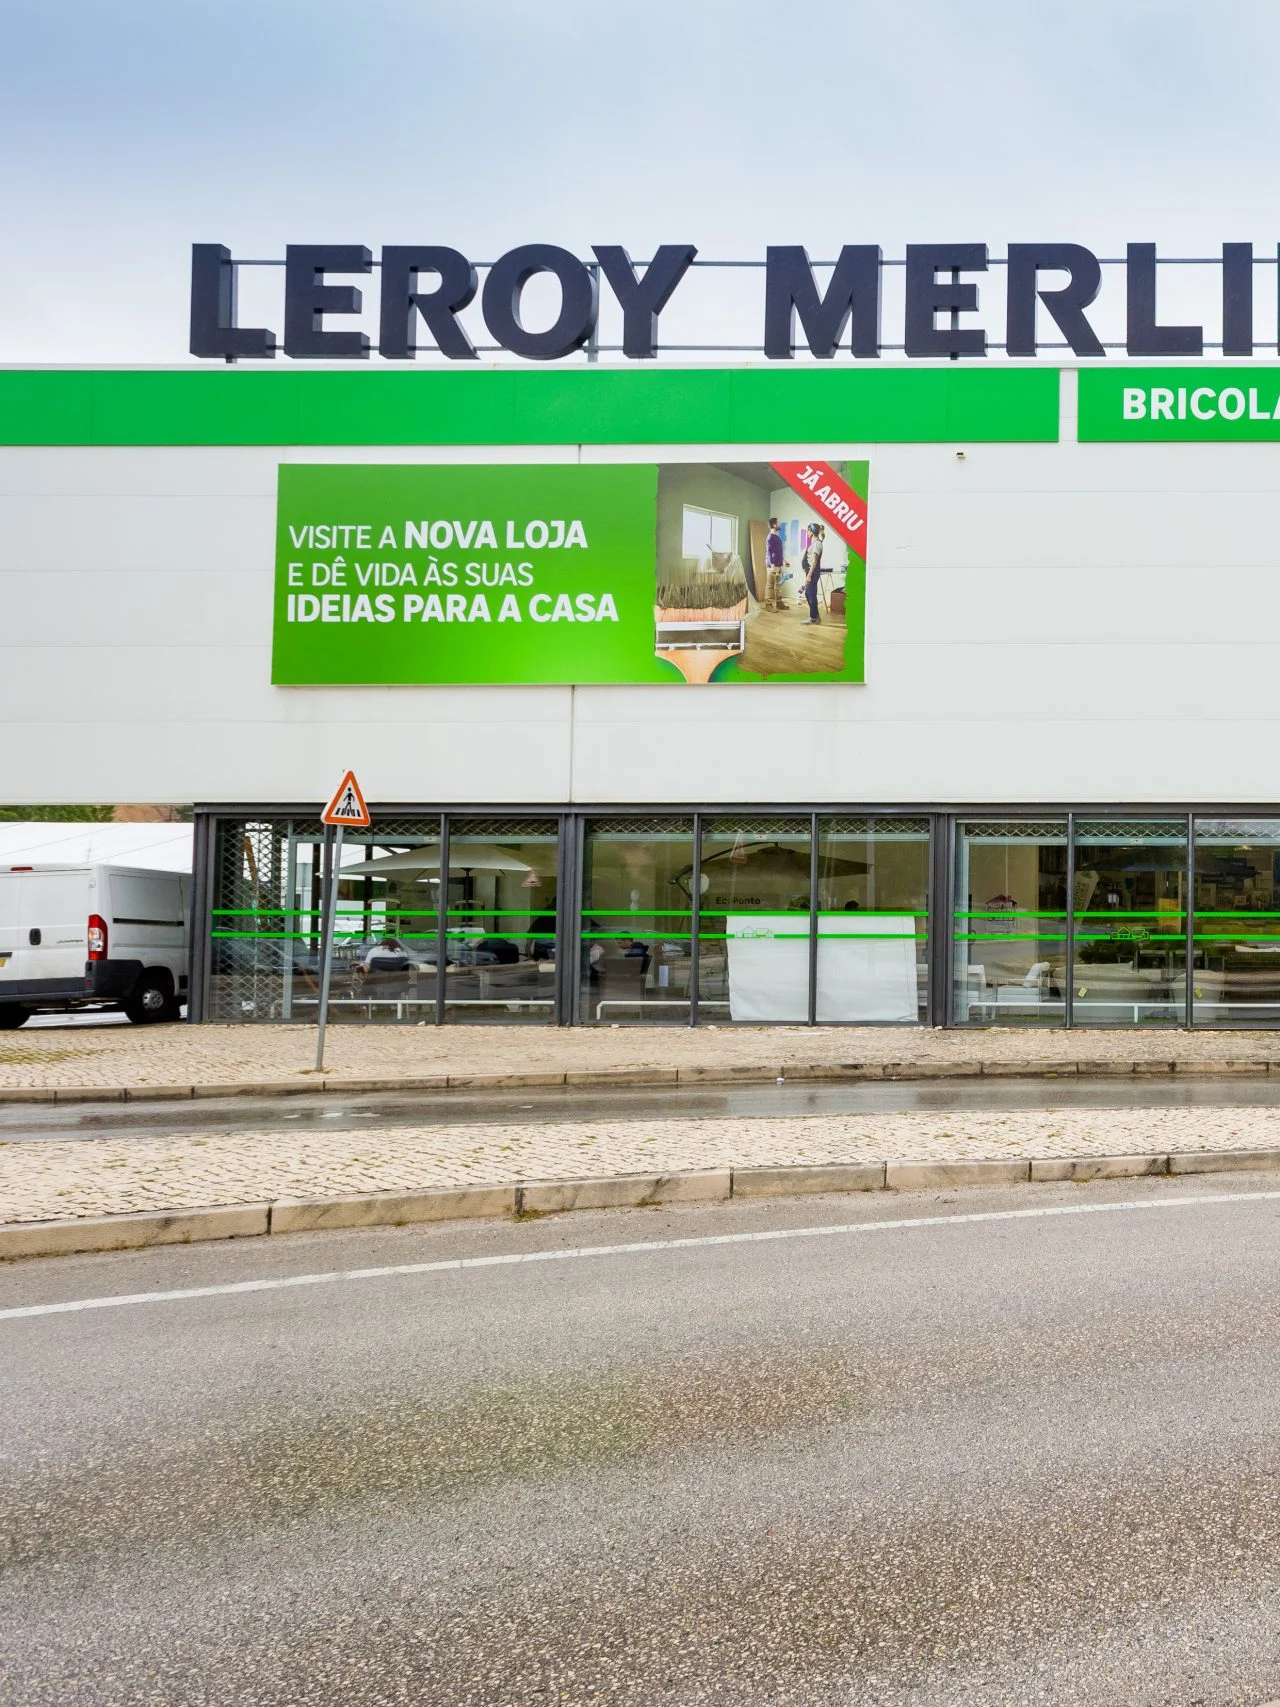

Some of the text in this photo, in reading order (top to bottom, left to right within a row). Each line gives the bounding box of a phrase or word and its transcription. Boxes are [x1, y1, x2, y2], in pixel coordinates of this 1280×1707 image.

[190, 242, 699, 361] LEROY
[796, 464, 864, 532] JÁ ABRIU
[288, 519, 589, 549] VISITE A NOVA LOJA
[288, 555, 535, 587] E DÊ VIDA ÀS SUAS
[287, 592, 620, 622] IDEIAS PARA A CASA
